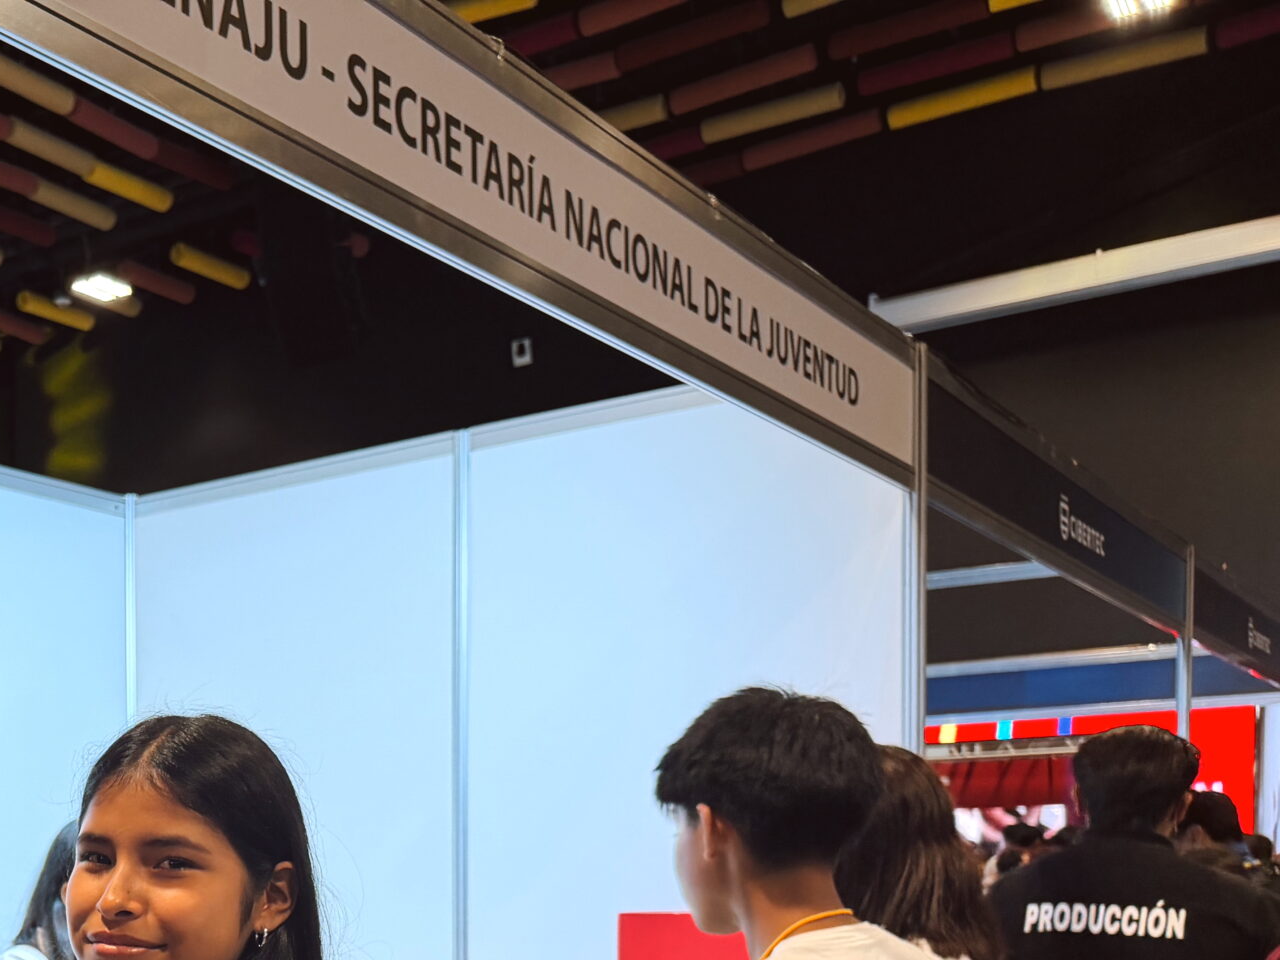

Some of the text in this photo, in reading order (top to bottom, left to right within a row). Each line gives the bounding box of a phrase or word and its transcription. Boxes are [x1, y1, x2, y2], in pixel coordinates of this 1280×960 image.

[322, 65, 335, 82] -
[347, 53, 557, 232] SECRETARÍA
[565, 188, 698, 314] NACIONAL
[704, 276, 732, 334] DE
[737, 297, 762, 352] LA
[766, 317, 859, 406] JUVENTUD
[1023, 899, 1187, 940] PRODUCCIÓN
